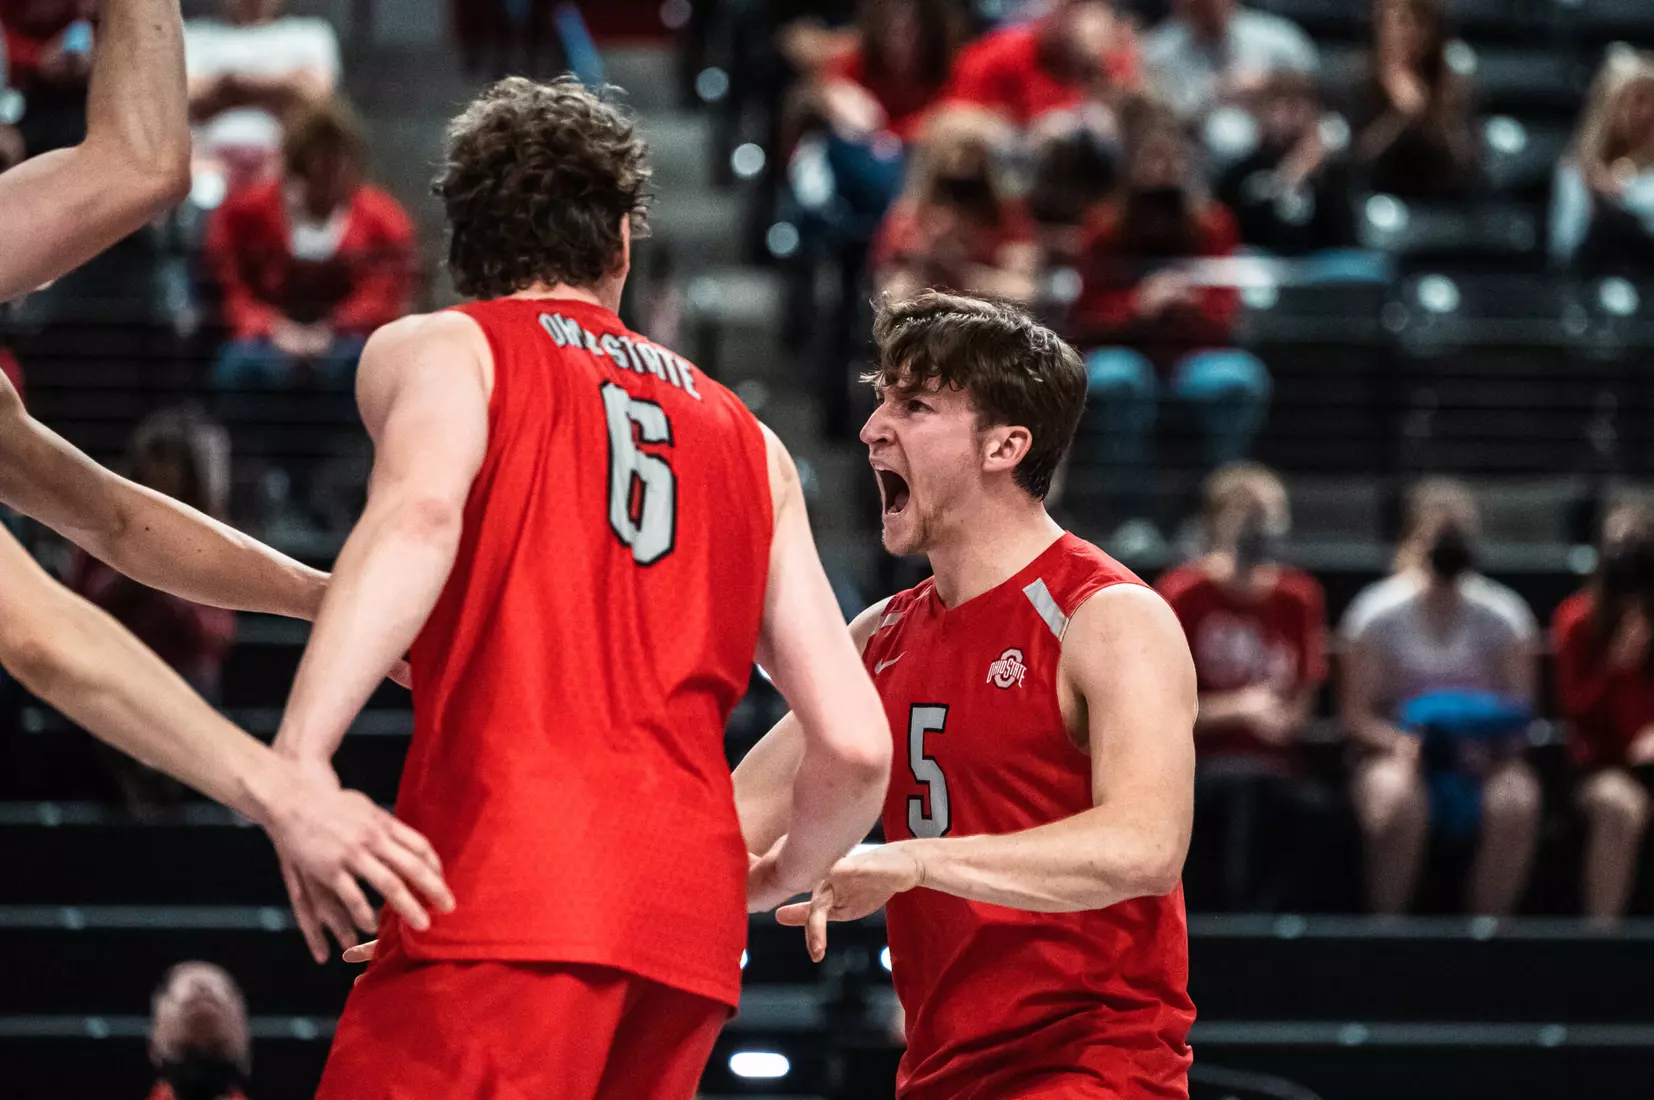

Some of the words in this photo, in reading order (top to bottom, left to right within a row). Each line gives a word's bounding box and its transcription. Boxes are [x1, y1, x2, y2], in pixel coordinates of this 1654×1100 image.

[538, 312, 604, 356] OHO
[600, 333, 702, 400] STATE
[599, 379, 677, 567] 6
[1003, 658, 1027, 688] STATE
[906, 702, 952, 839] 5
